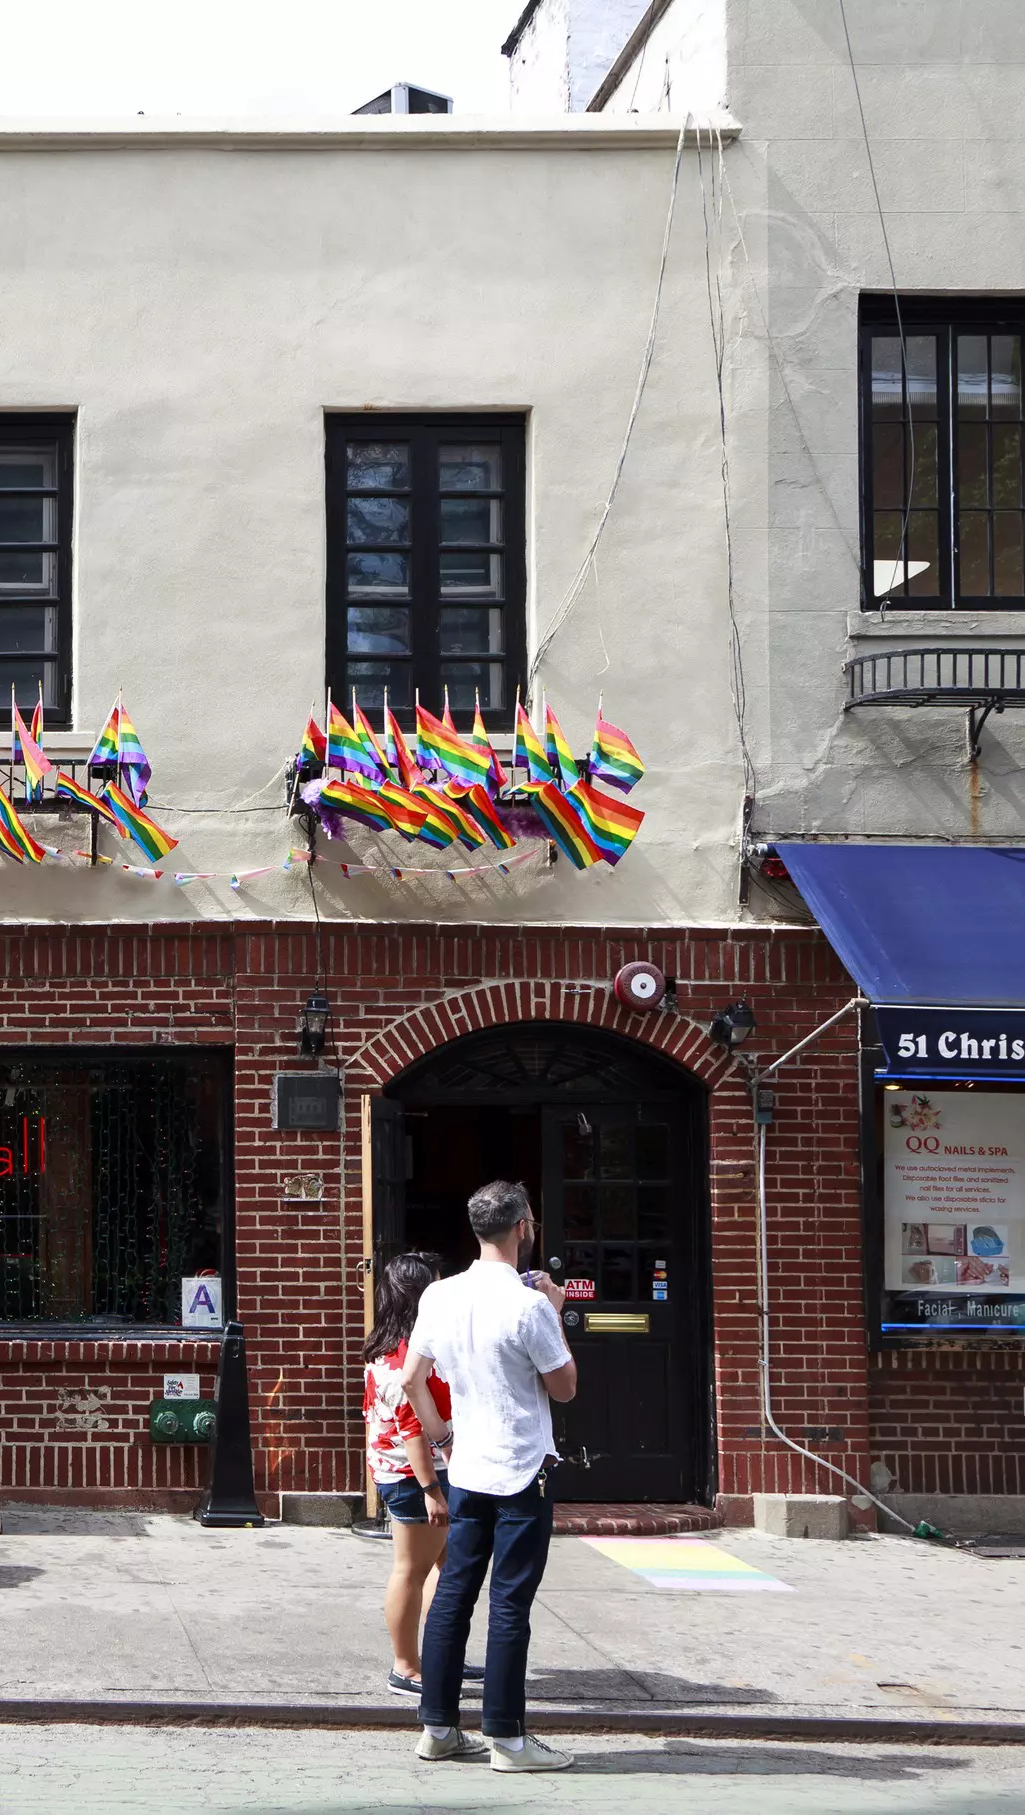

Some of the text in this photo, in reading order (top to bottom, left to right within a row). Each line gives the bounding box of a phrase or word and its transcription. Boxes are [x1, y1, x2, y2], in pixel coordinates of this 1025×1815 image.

[897, 1031, 1025, 1060] 51 Chris
[905, 1135, 1008, 1156] QQ NAILS & SPA
[895, 1164, 905, 1172] We
[958, 1165, 977, 1173] metal
[902, 1174, 937, 1183] Disposable
[938, 1174, 952, 1182] foot
[966, 1175, 980, 1183] and
[917, 1194, 930, 1202] also
[566, 1280, 593, 1290] ATM
[189, 1284, 216, 1314] A
[966, 1300, 1020, 1317] Manicure
